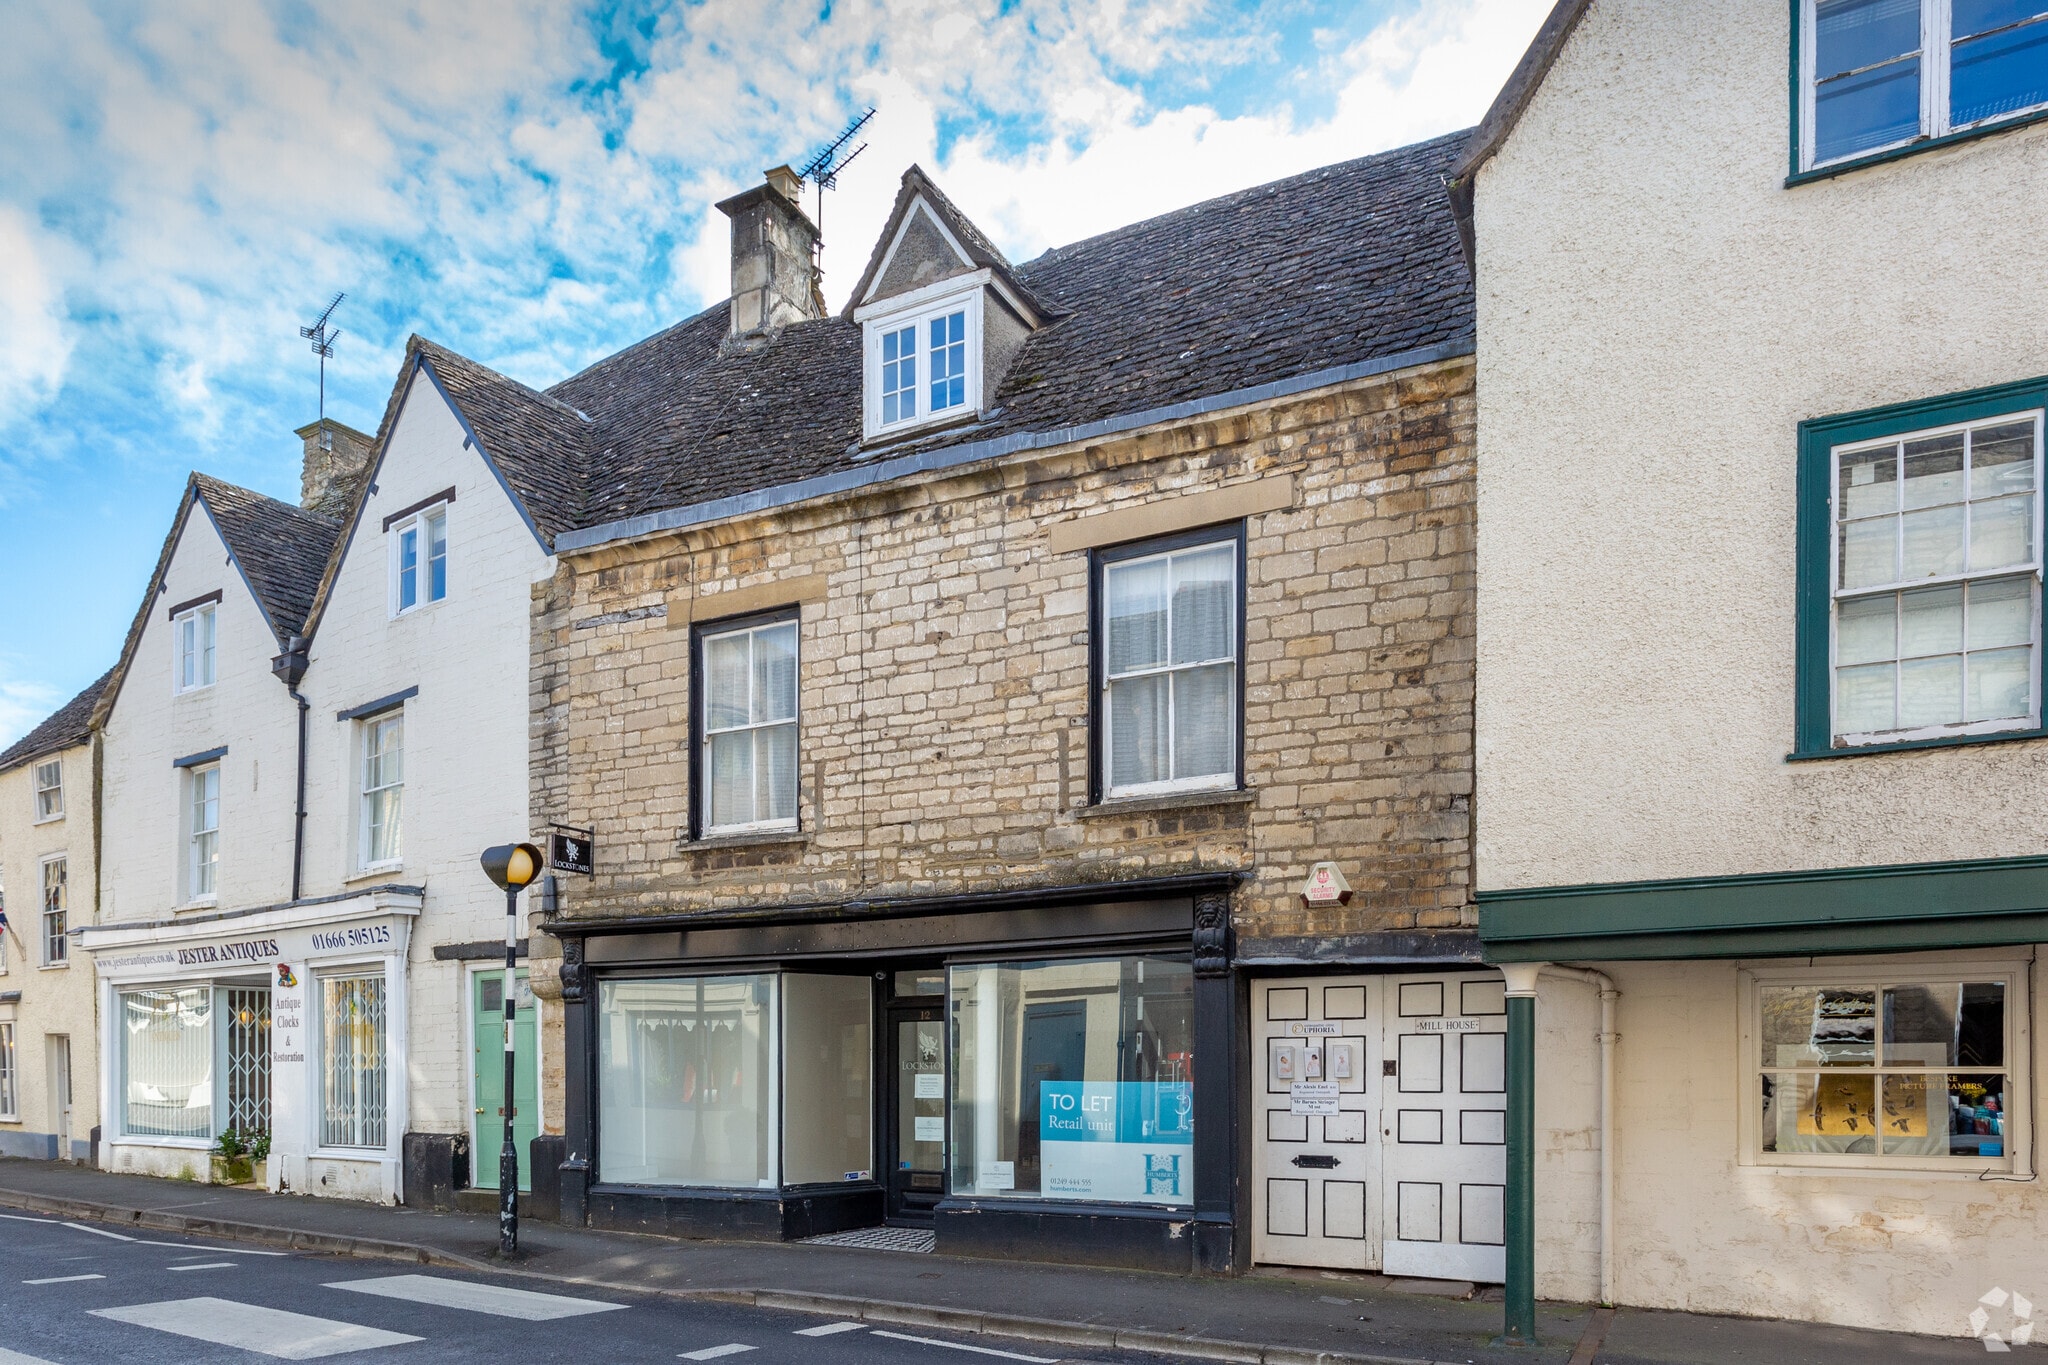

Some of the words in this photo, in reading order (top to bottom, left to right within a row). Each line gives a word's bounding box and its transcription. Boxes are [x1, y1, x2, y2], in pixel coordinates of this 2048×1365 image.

[312, 933, 346, 950] 01666
[347, 925, 390, 946] 505125
[177, 946, 219, 965] JESTER
[220, 939, 279, 962] ANTIQUES
[97, 951, 176, 970] www.jesterantiques.co.uk
[275, 997, 301, 1012] Antique
[277, 1015, 300, 1029] Clocks
[920, 1010, 931, 1020] 12
[1419, 1021, 1443, 1030] MILL
[1446, 1020, 1475, 1030] HOUSE
[285, 1035, 291, 1047] &
[273, 1051, 304, 1062] Restoration
[1049, 1094, 1075, 1110] TO
[1081, 1095, 1113, 1112] LET
[1048, 1114, 1083, 1130] Retail
[1087, 1118, 1113, 1132] unit
[1049, 1185, 1092, 1193] humberts.com
[1082, 1179, 1092, 1187] 555
